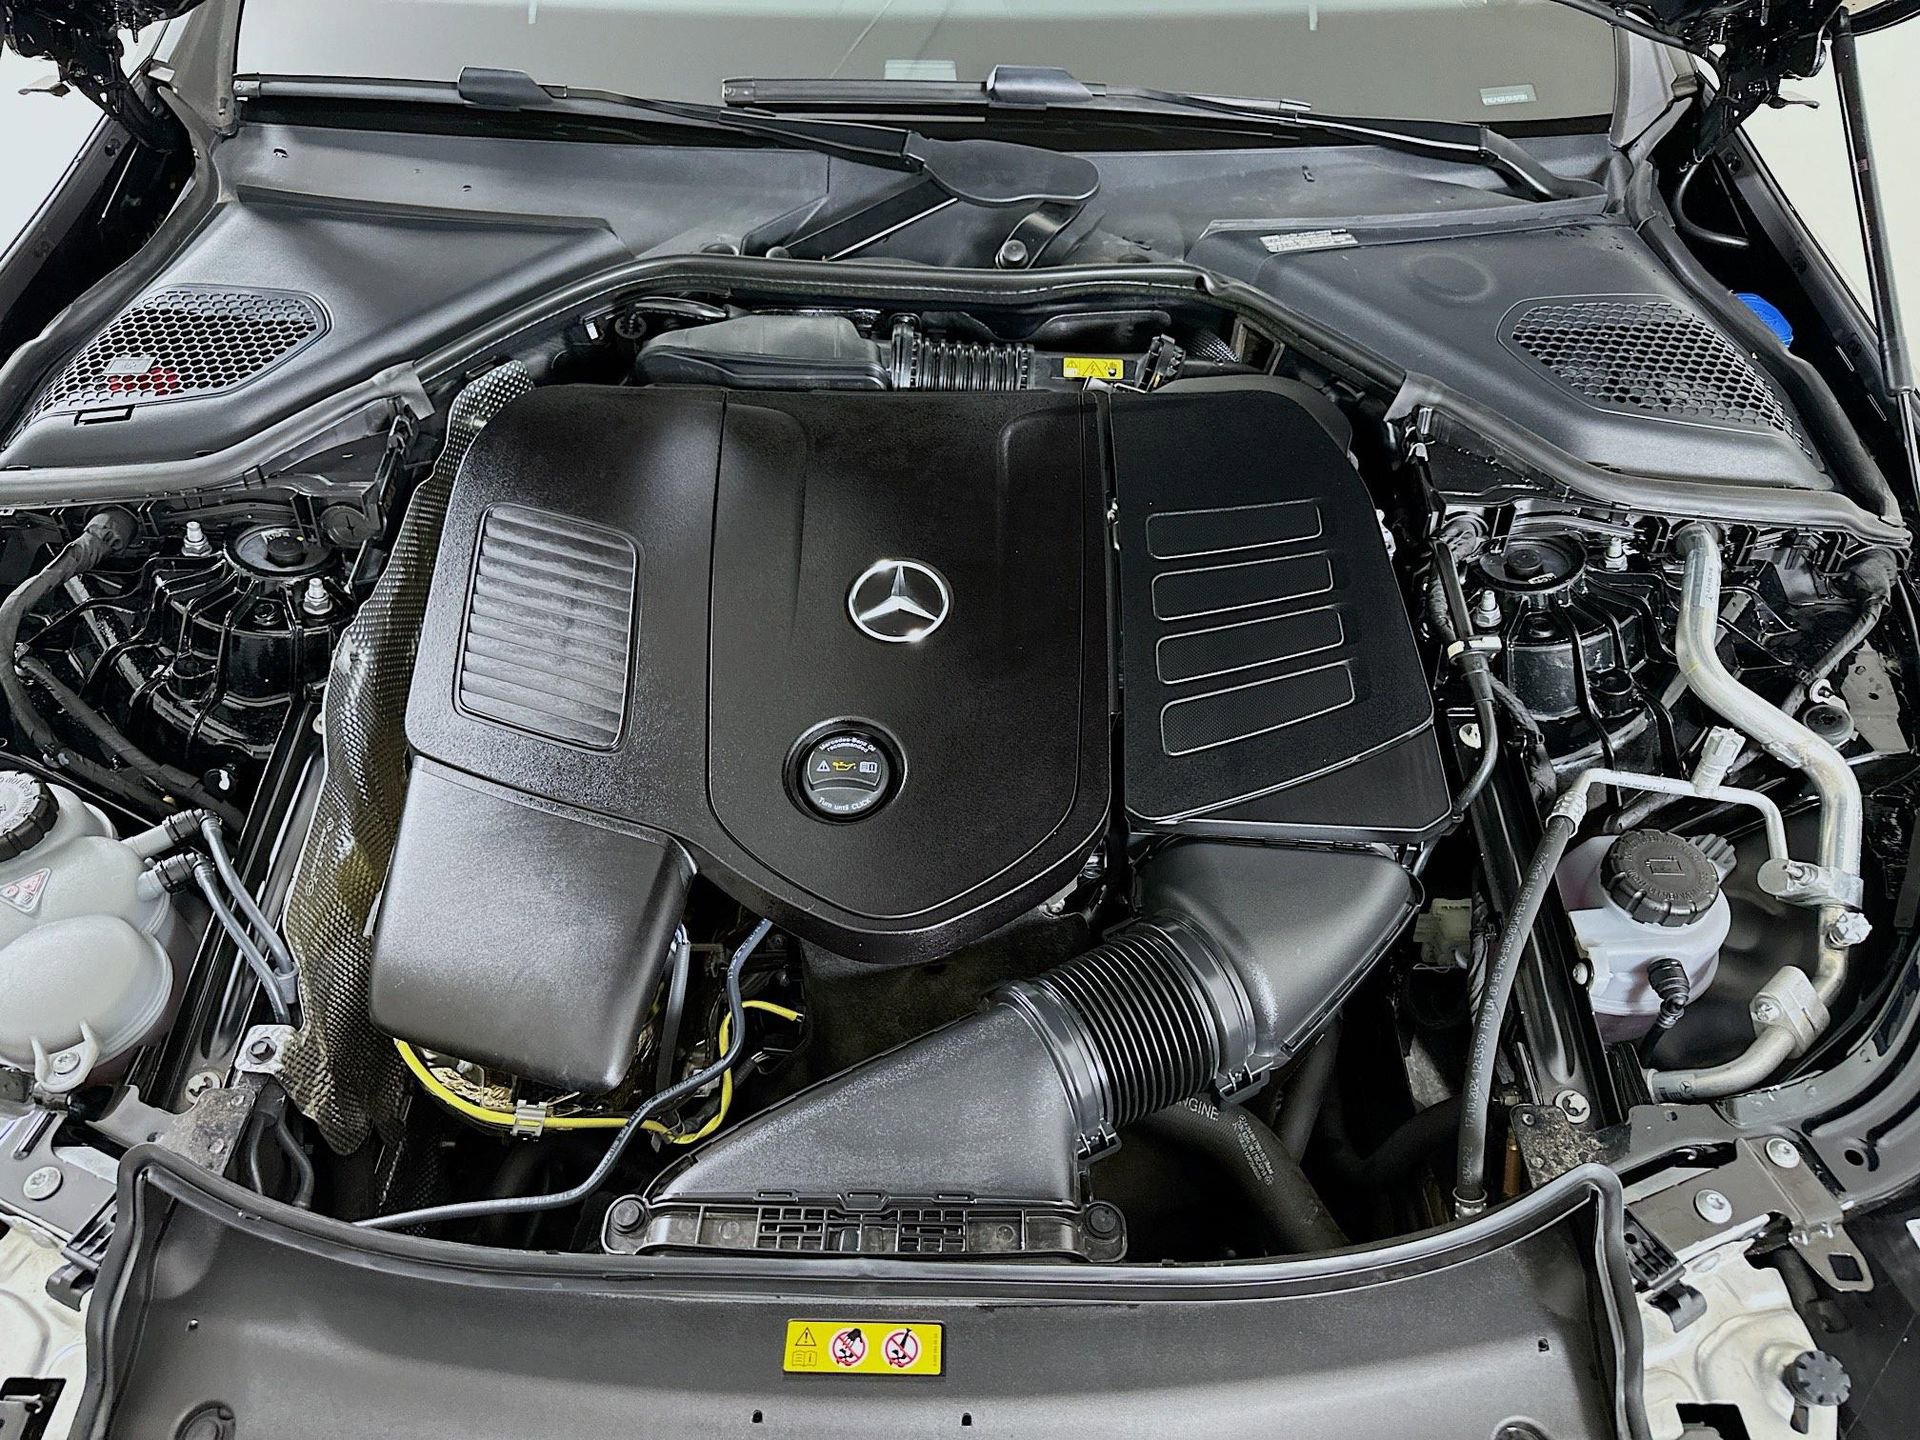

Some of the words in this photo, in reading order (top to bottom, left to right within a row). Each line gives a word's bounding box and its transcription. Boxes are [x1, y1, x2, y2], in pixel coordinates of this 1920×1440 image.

[819, 737, 868, 750] Mercedes-Benz
[827, 742, 868, 753] recommended
[819, 796, 833, 808] Turn
[851, 798, 871, 810] CLICK
[1176, 1096, 1220, 1121] NGINE
